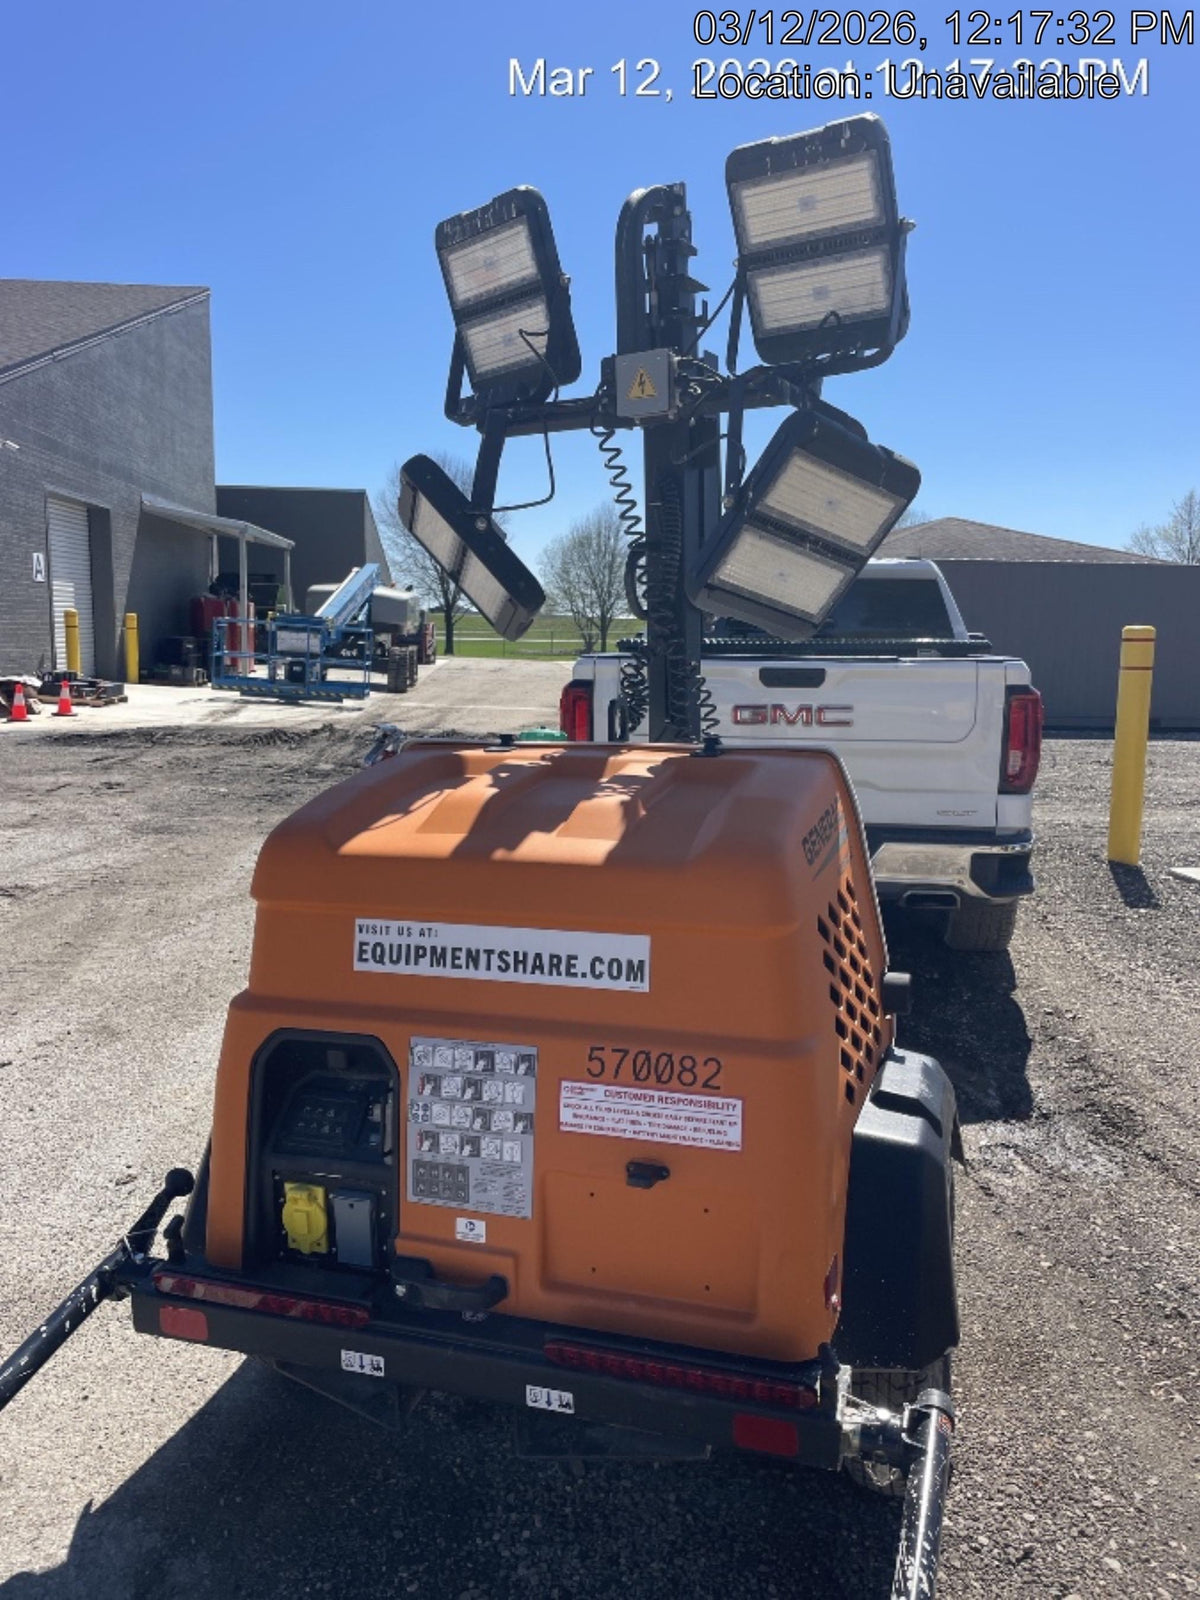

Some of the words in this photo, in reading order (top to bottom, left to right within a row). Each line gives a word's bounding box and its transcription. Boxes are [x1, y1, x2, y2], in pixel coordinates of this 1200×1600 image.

[34, 554, 44, 579] A
[731, 703, 854, 727] GMC
[358, 924, 391, 936] VISIT
[397, 926, 413, 938] US
[418, 927, 439, 938] AT:
[357, 941, 645, 983] EQUIPMENTSHARE.COM
[586, 1046, 722, 1090] 570082
[604, 1089, 655, 1103] CUSTOMER
[657, 1095, 738, 1112] RESPONSIBILITY
